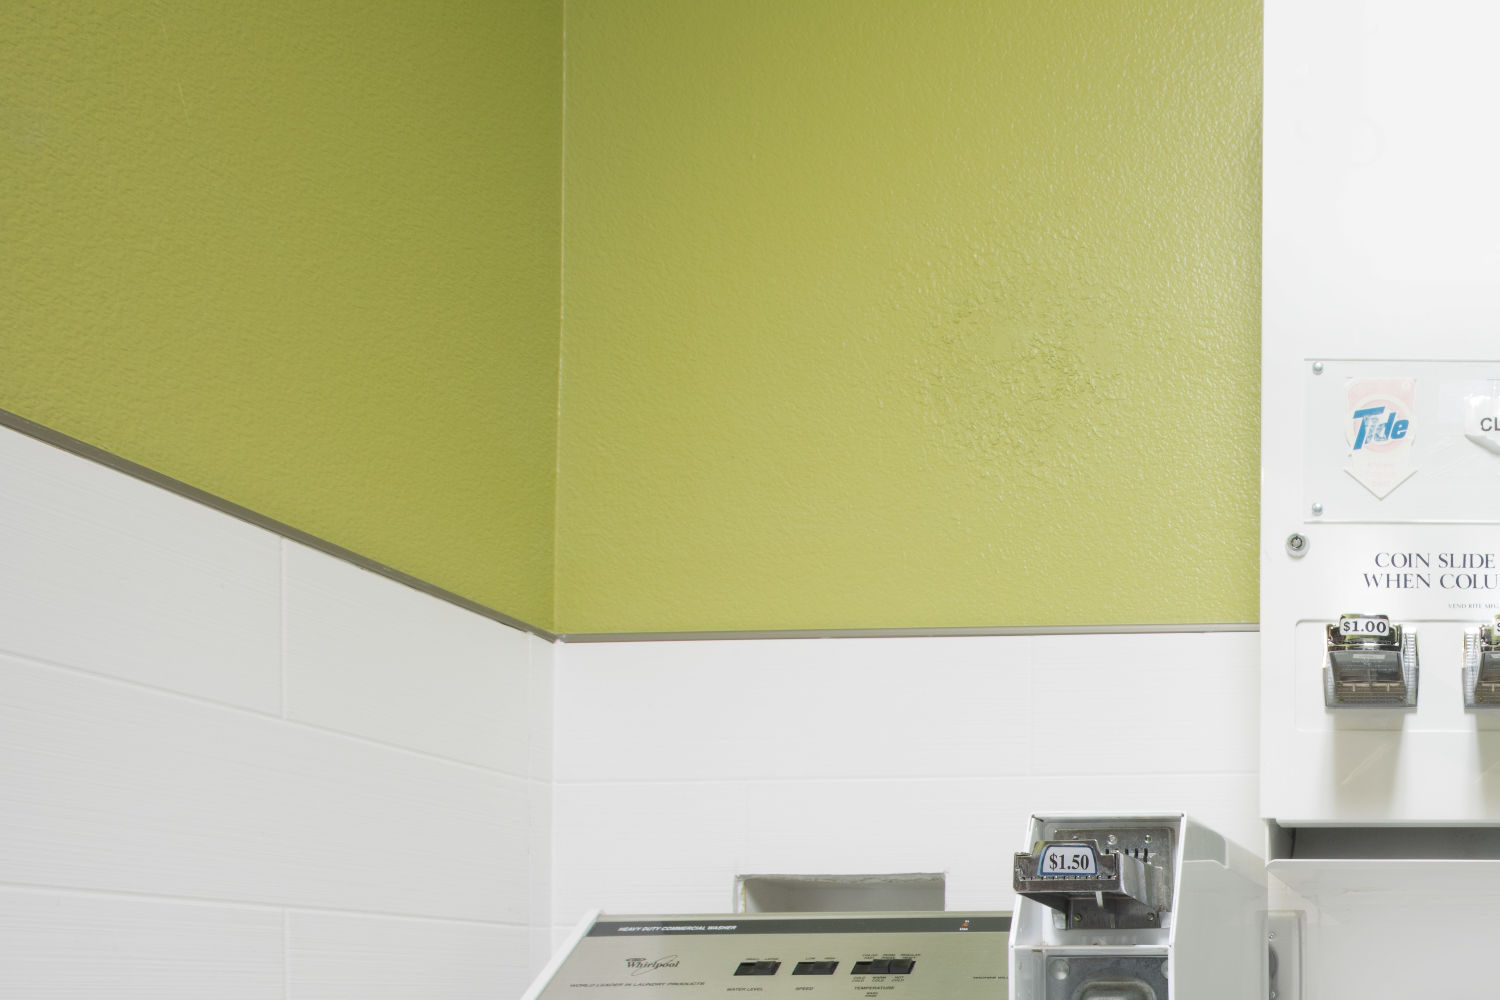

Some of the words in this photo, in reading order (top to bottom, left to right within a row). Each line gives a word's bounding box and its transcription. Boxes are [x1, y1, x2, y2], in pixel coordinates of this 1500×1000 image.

[1352, 405, 1409, 450] Tide
[1374, 552, 1431, 569] COIN
[1438, 553, 1496, 569] SLIDE
[1363, 573, 1431, 589] WHEN
[1343, 620, 1387, 634] $1.00
[1049, 853, 1090, 871] $1.50
[626, 958, 680, 972] Whirlpool
